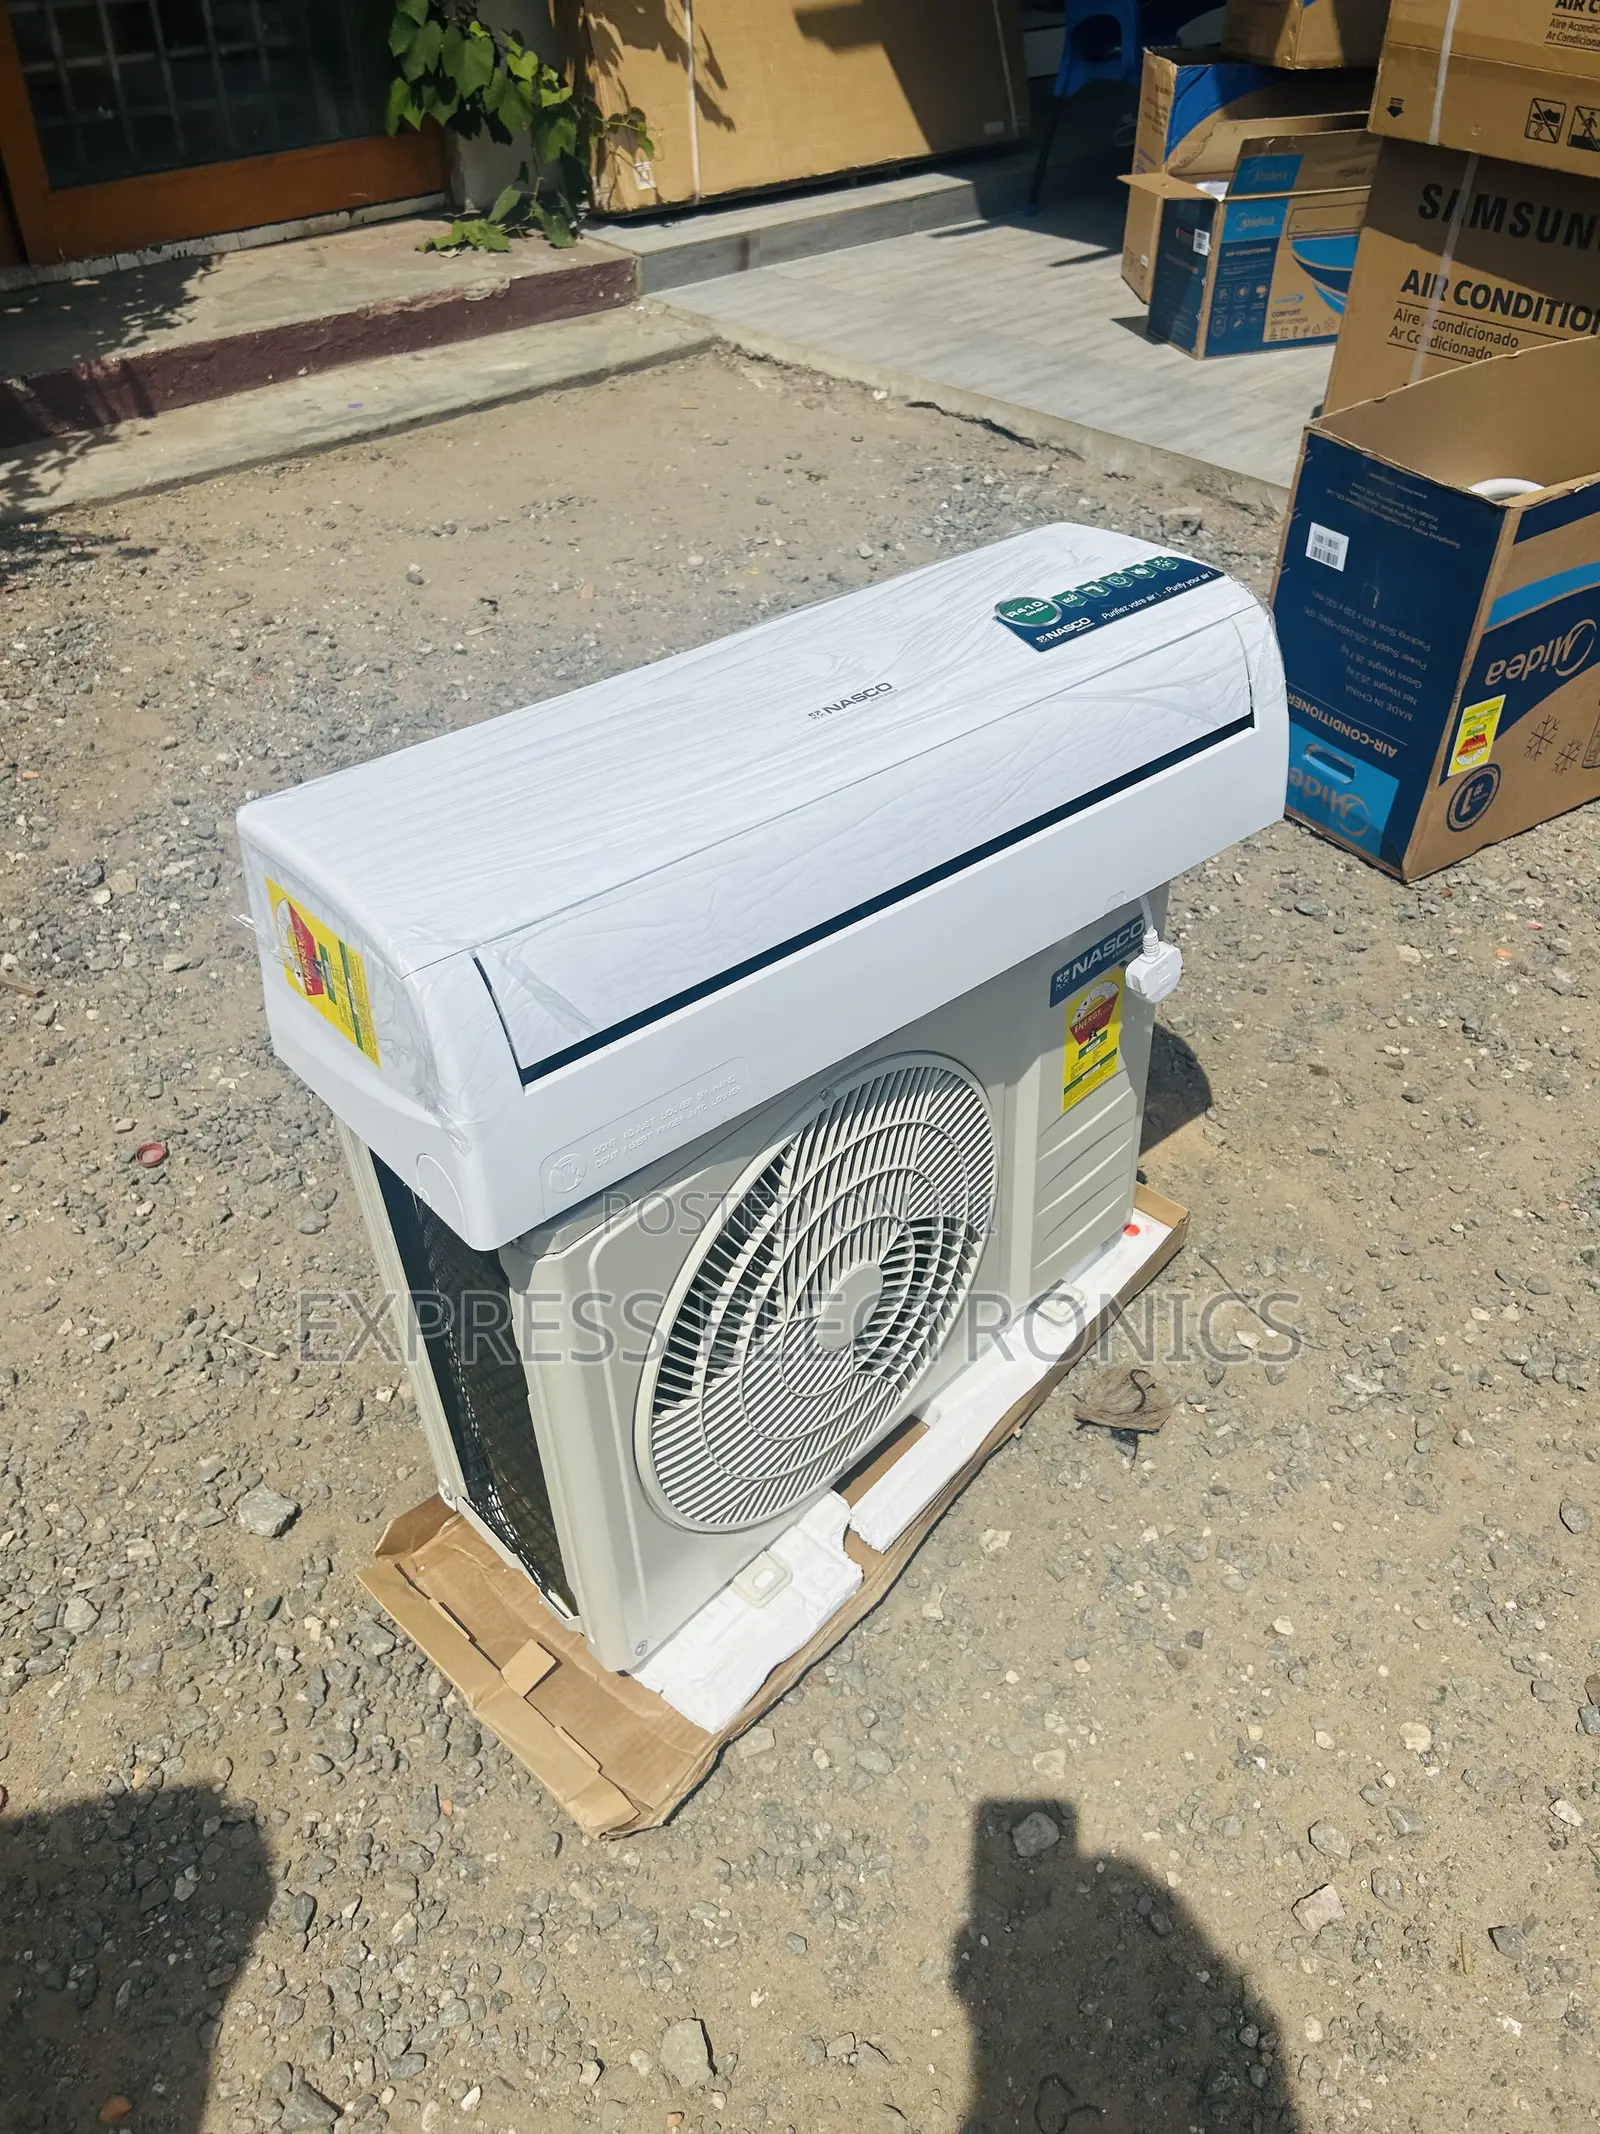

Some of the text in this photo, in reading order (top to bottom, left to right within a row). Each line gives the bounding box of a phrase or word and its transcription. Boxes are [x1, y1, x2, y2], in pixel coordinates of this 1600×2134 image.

[1418, 183, 1600, 251] SAMSUN
[1400, 269, 1449, 302] AIR
[1389, 326, 1493, 361] Ar Codicionado
[1393, 308, 1519, 348] Aire condicionado
[1045, 617, 1091, 640] NASCO
[1400, 653, 1427, 671] Power
[1485, 619, 1597, 686] Midea
[1398, 671, 1422, 688] Gross
[823, 682, 892, 714] NASCO
[1345, 684, 1413, 721] MADE IN CHINA
[1402, 693, 1418, 706] Net
[1287, 693, 1398, 758] AIR-CONDITIONER
[1288, 766, 1371, 837] Mide
[1071, 918, 1145, 980] NASCO
[623, 1116, 656, 1140] ADJUST
